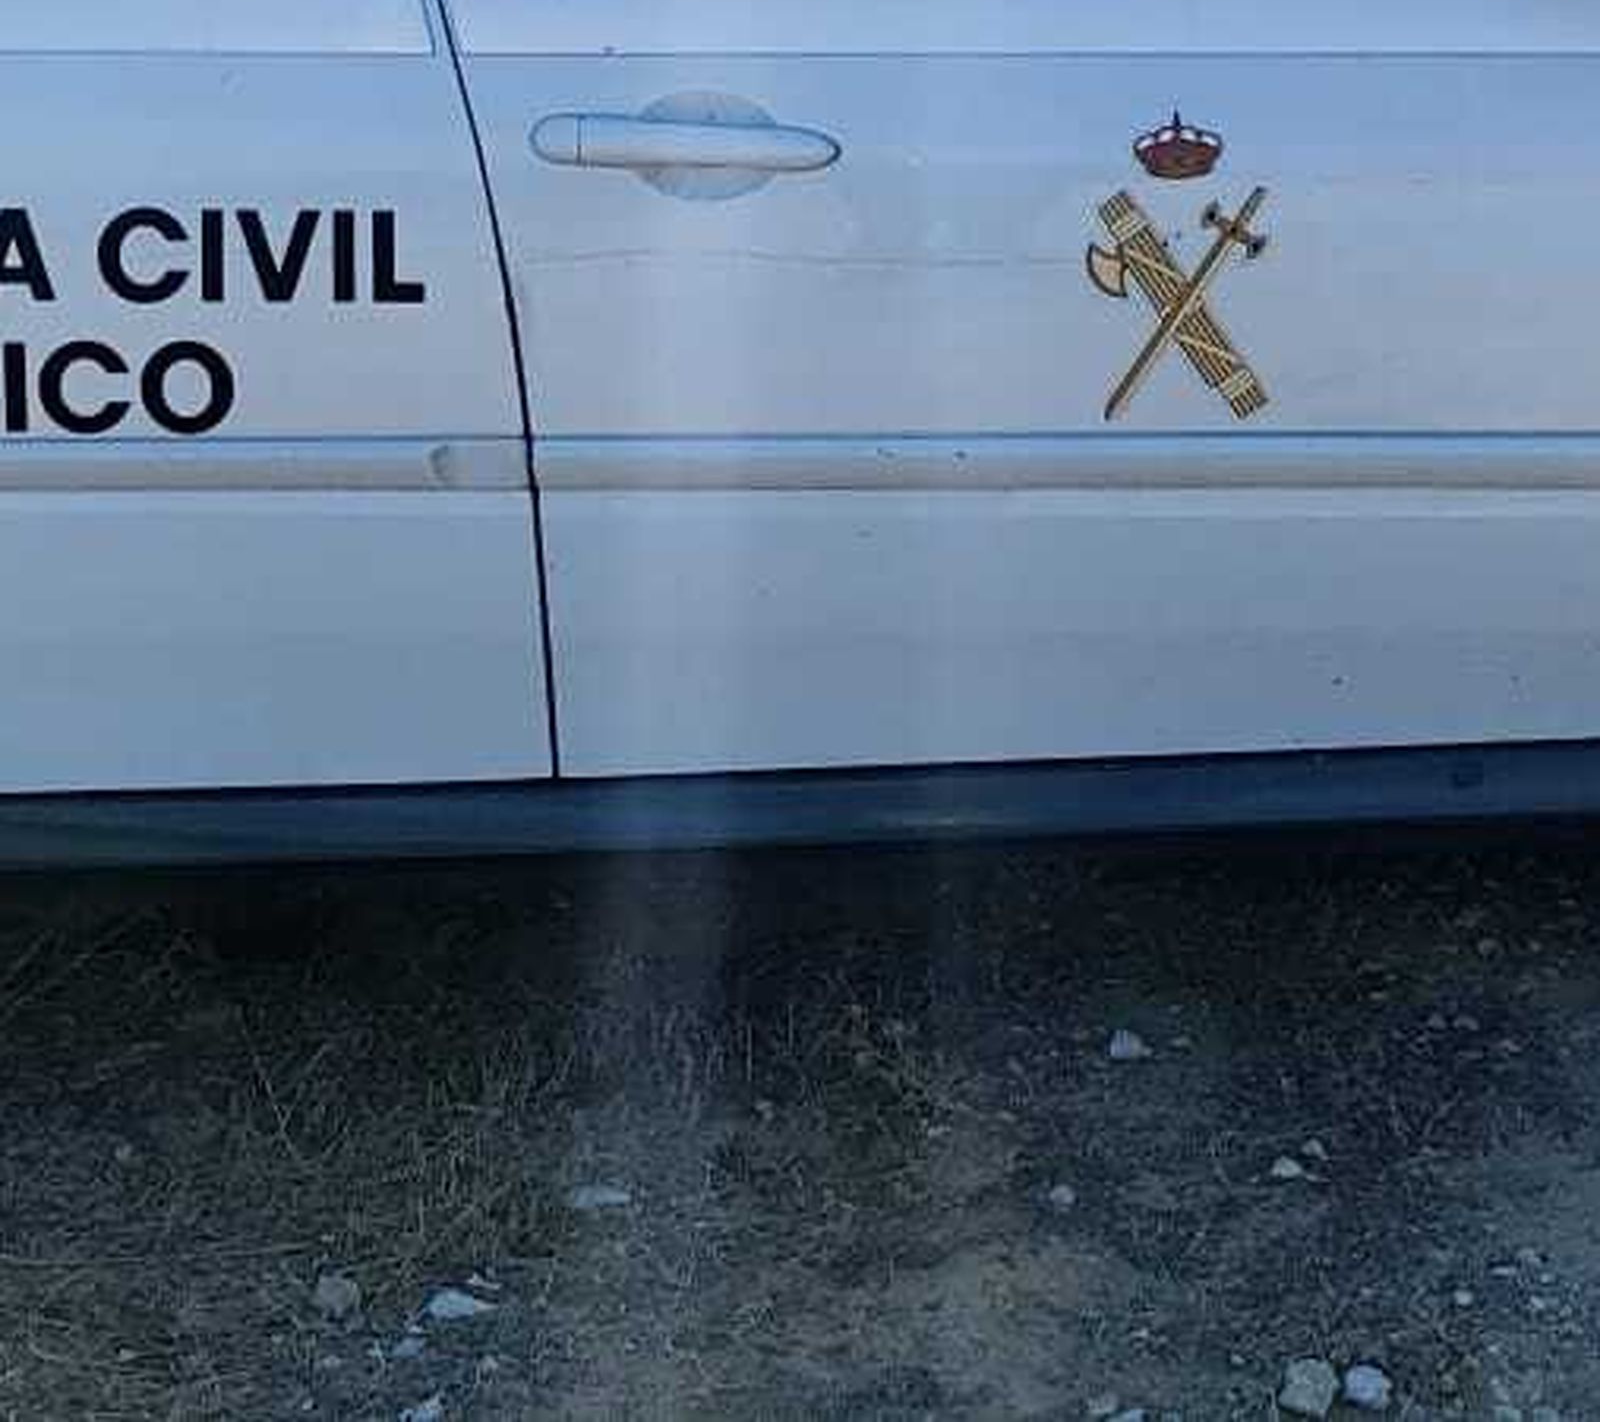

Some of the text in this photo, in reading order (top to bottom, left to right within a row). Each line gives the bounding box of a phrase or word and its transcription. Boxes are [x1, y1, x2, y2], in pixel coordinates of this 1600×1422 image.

[0, 206, 425, 303] A CIVIL
[3, 339, 235, 435] ICO
